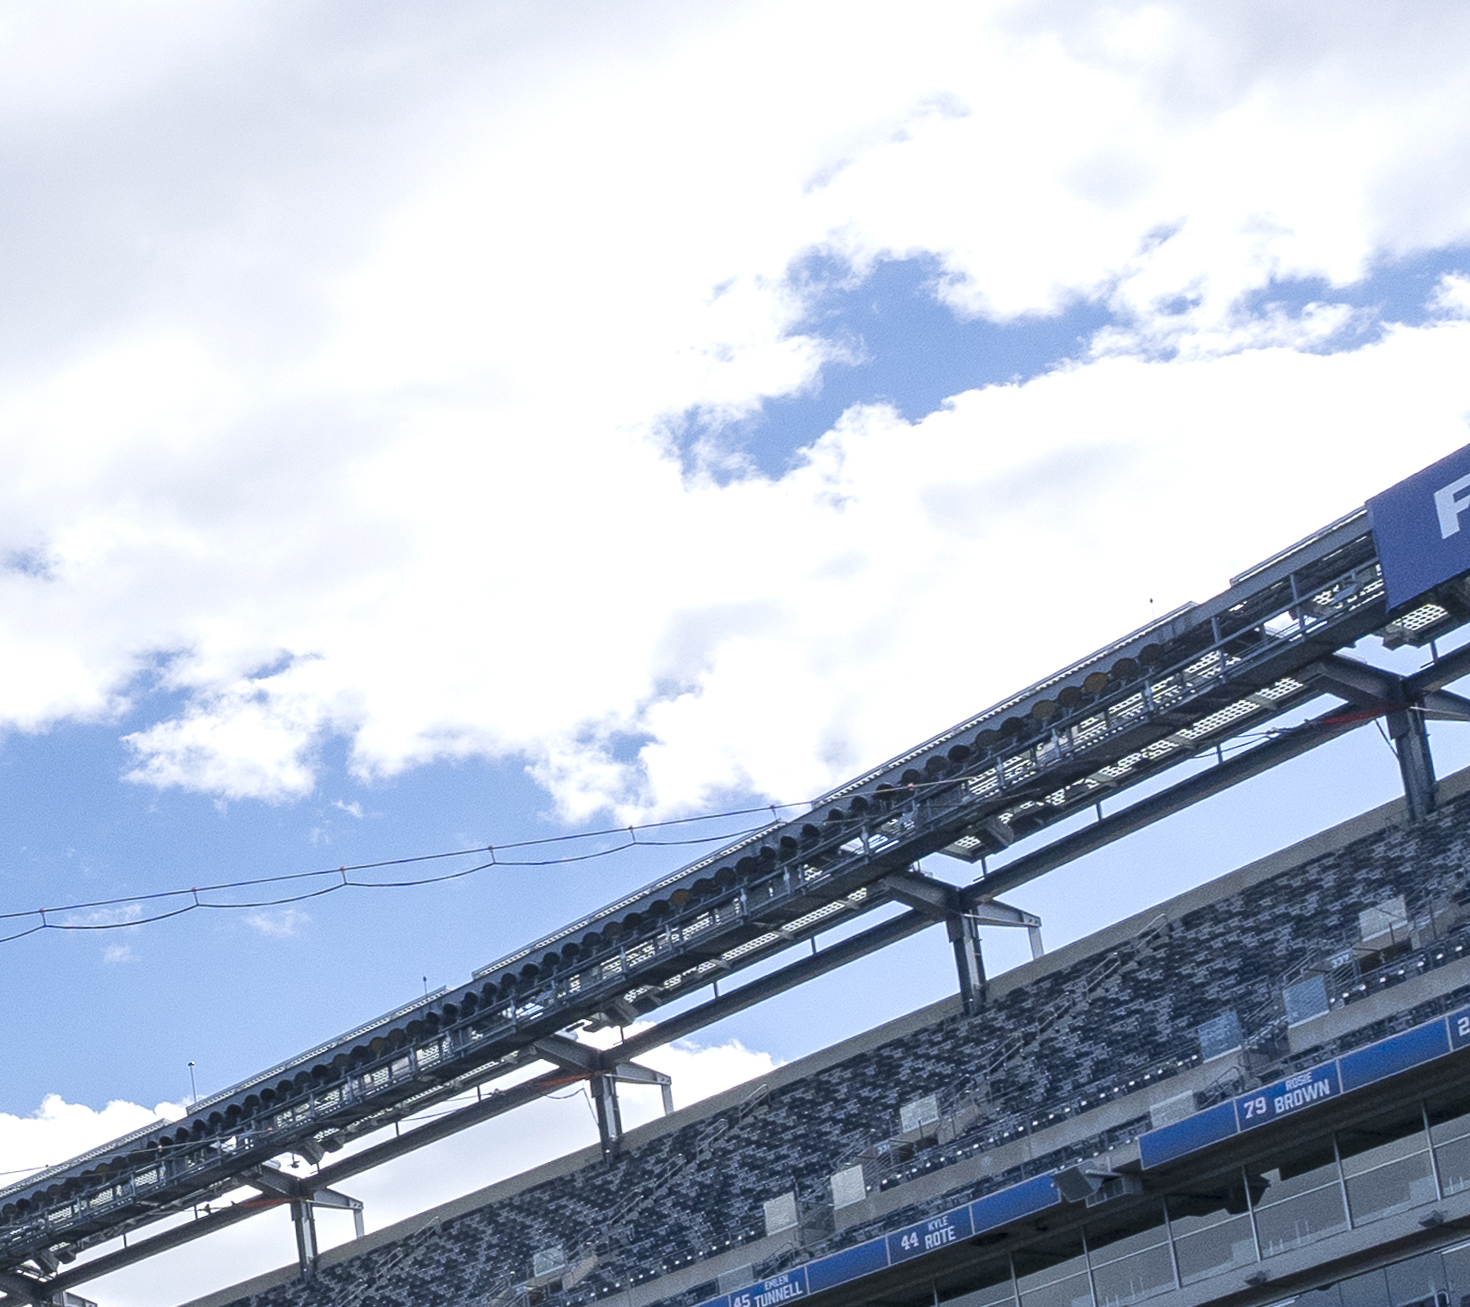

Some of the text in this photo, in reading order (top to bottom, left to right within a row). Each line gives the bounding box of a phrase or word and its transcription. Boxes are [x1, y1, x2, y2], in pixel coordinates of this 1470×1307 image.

[1434, 473, 1470, 540] F
[1285, 1072, 1312, 1091] ROSIE
[1243, 1078, 1330, 1119] 79 BROWN
[927, 1216, 948, 1232] KYLE
[901, 1226, 956, 1250] 44 ROTE
